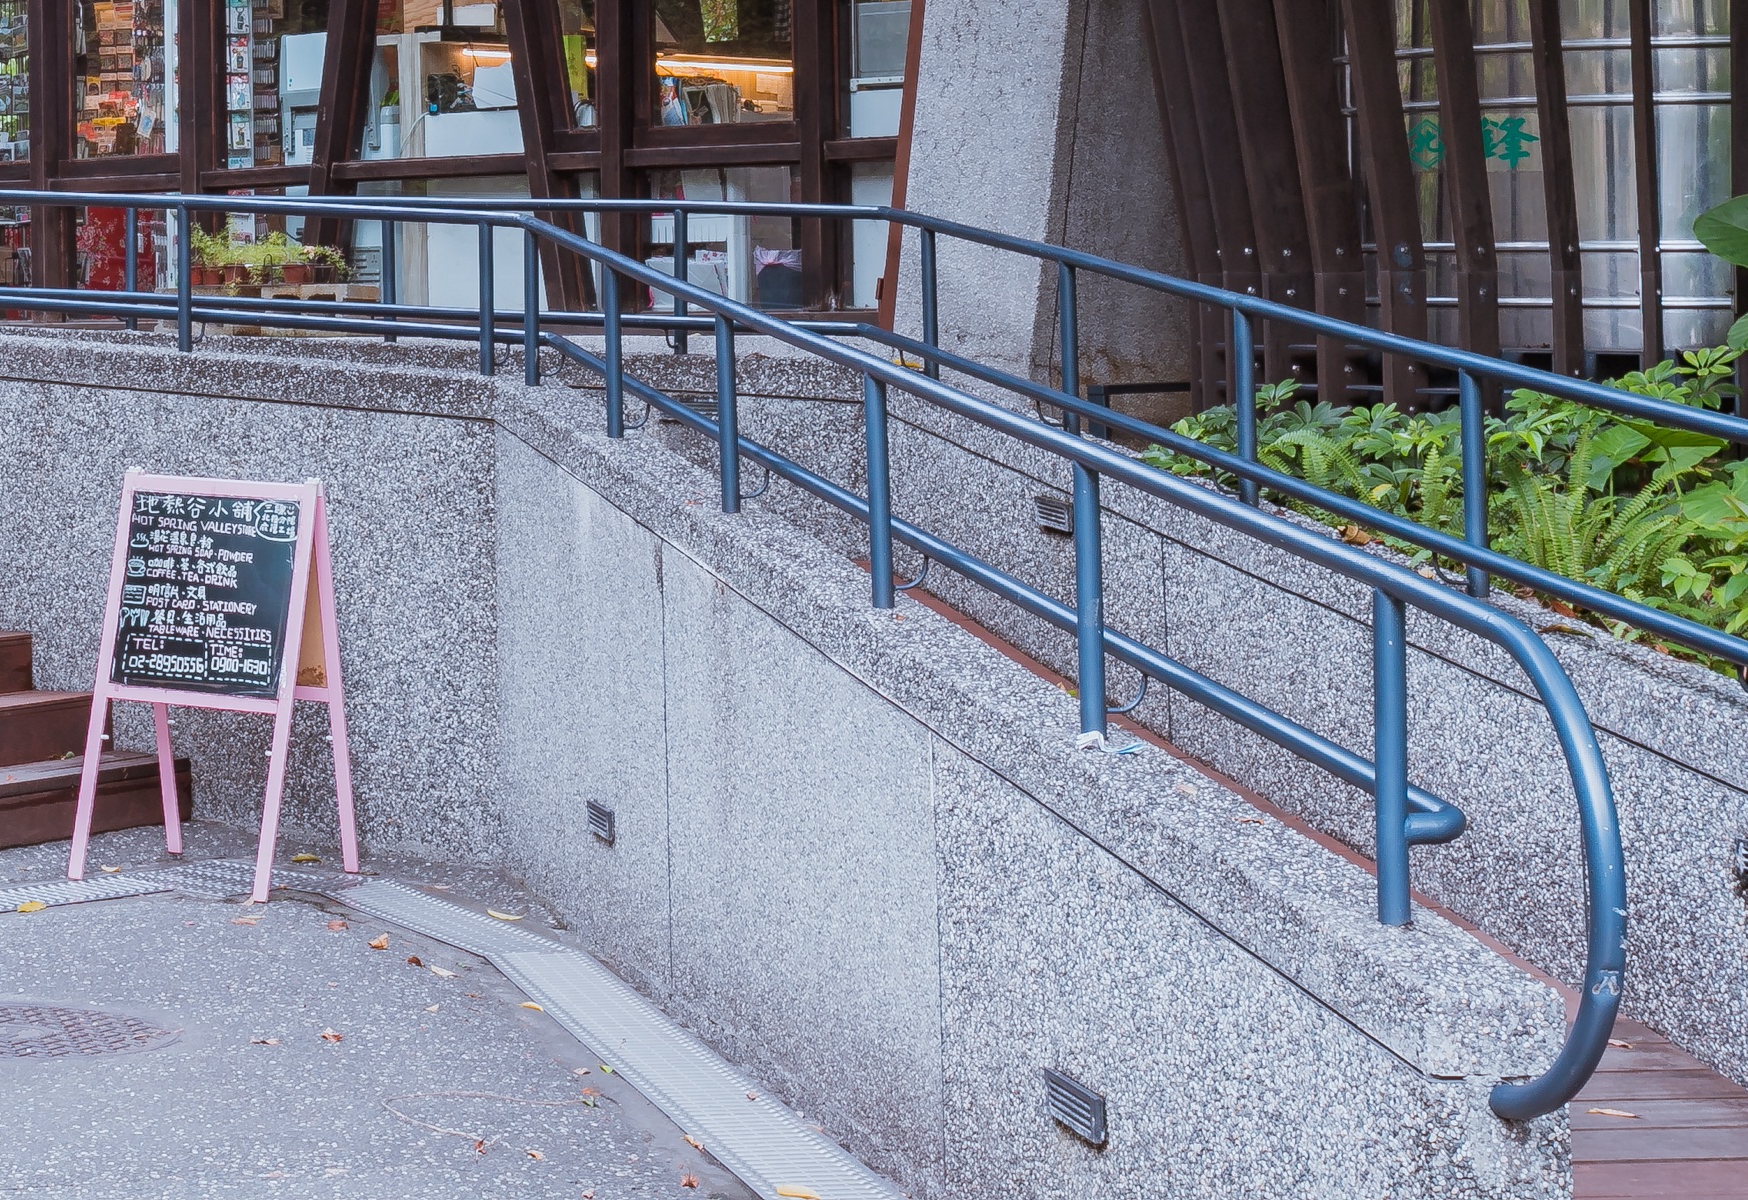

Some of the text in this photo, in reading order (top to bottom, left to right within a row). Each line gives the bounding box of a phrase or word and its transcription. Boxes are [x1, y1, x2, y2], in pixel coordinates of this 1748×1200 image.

[136, 495, 254, 521] 地熱谷小舖
[132, 513, 154, 526] HOT
[158, 516, 197, 532] SPRING
[149, 544, 164, 553] HOT
[166, 545, 192, 556] SPRING
[146, 597, 170, 609] POST
[171, 599, 196, 611] CARD
[133, 637, 164, 650] TEL:
[209, 643, 244, 658] TIME:
[128, 653, 204, 673] 02-28950556
[211, 656, 268, 675] 0900-1630
